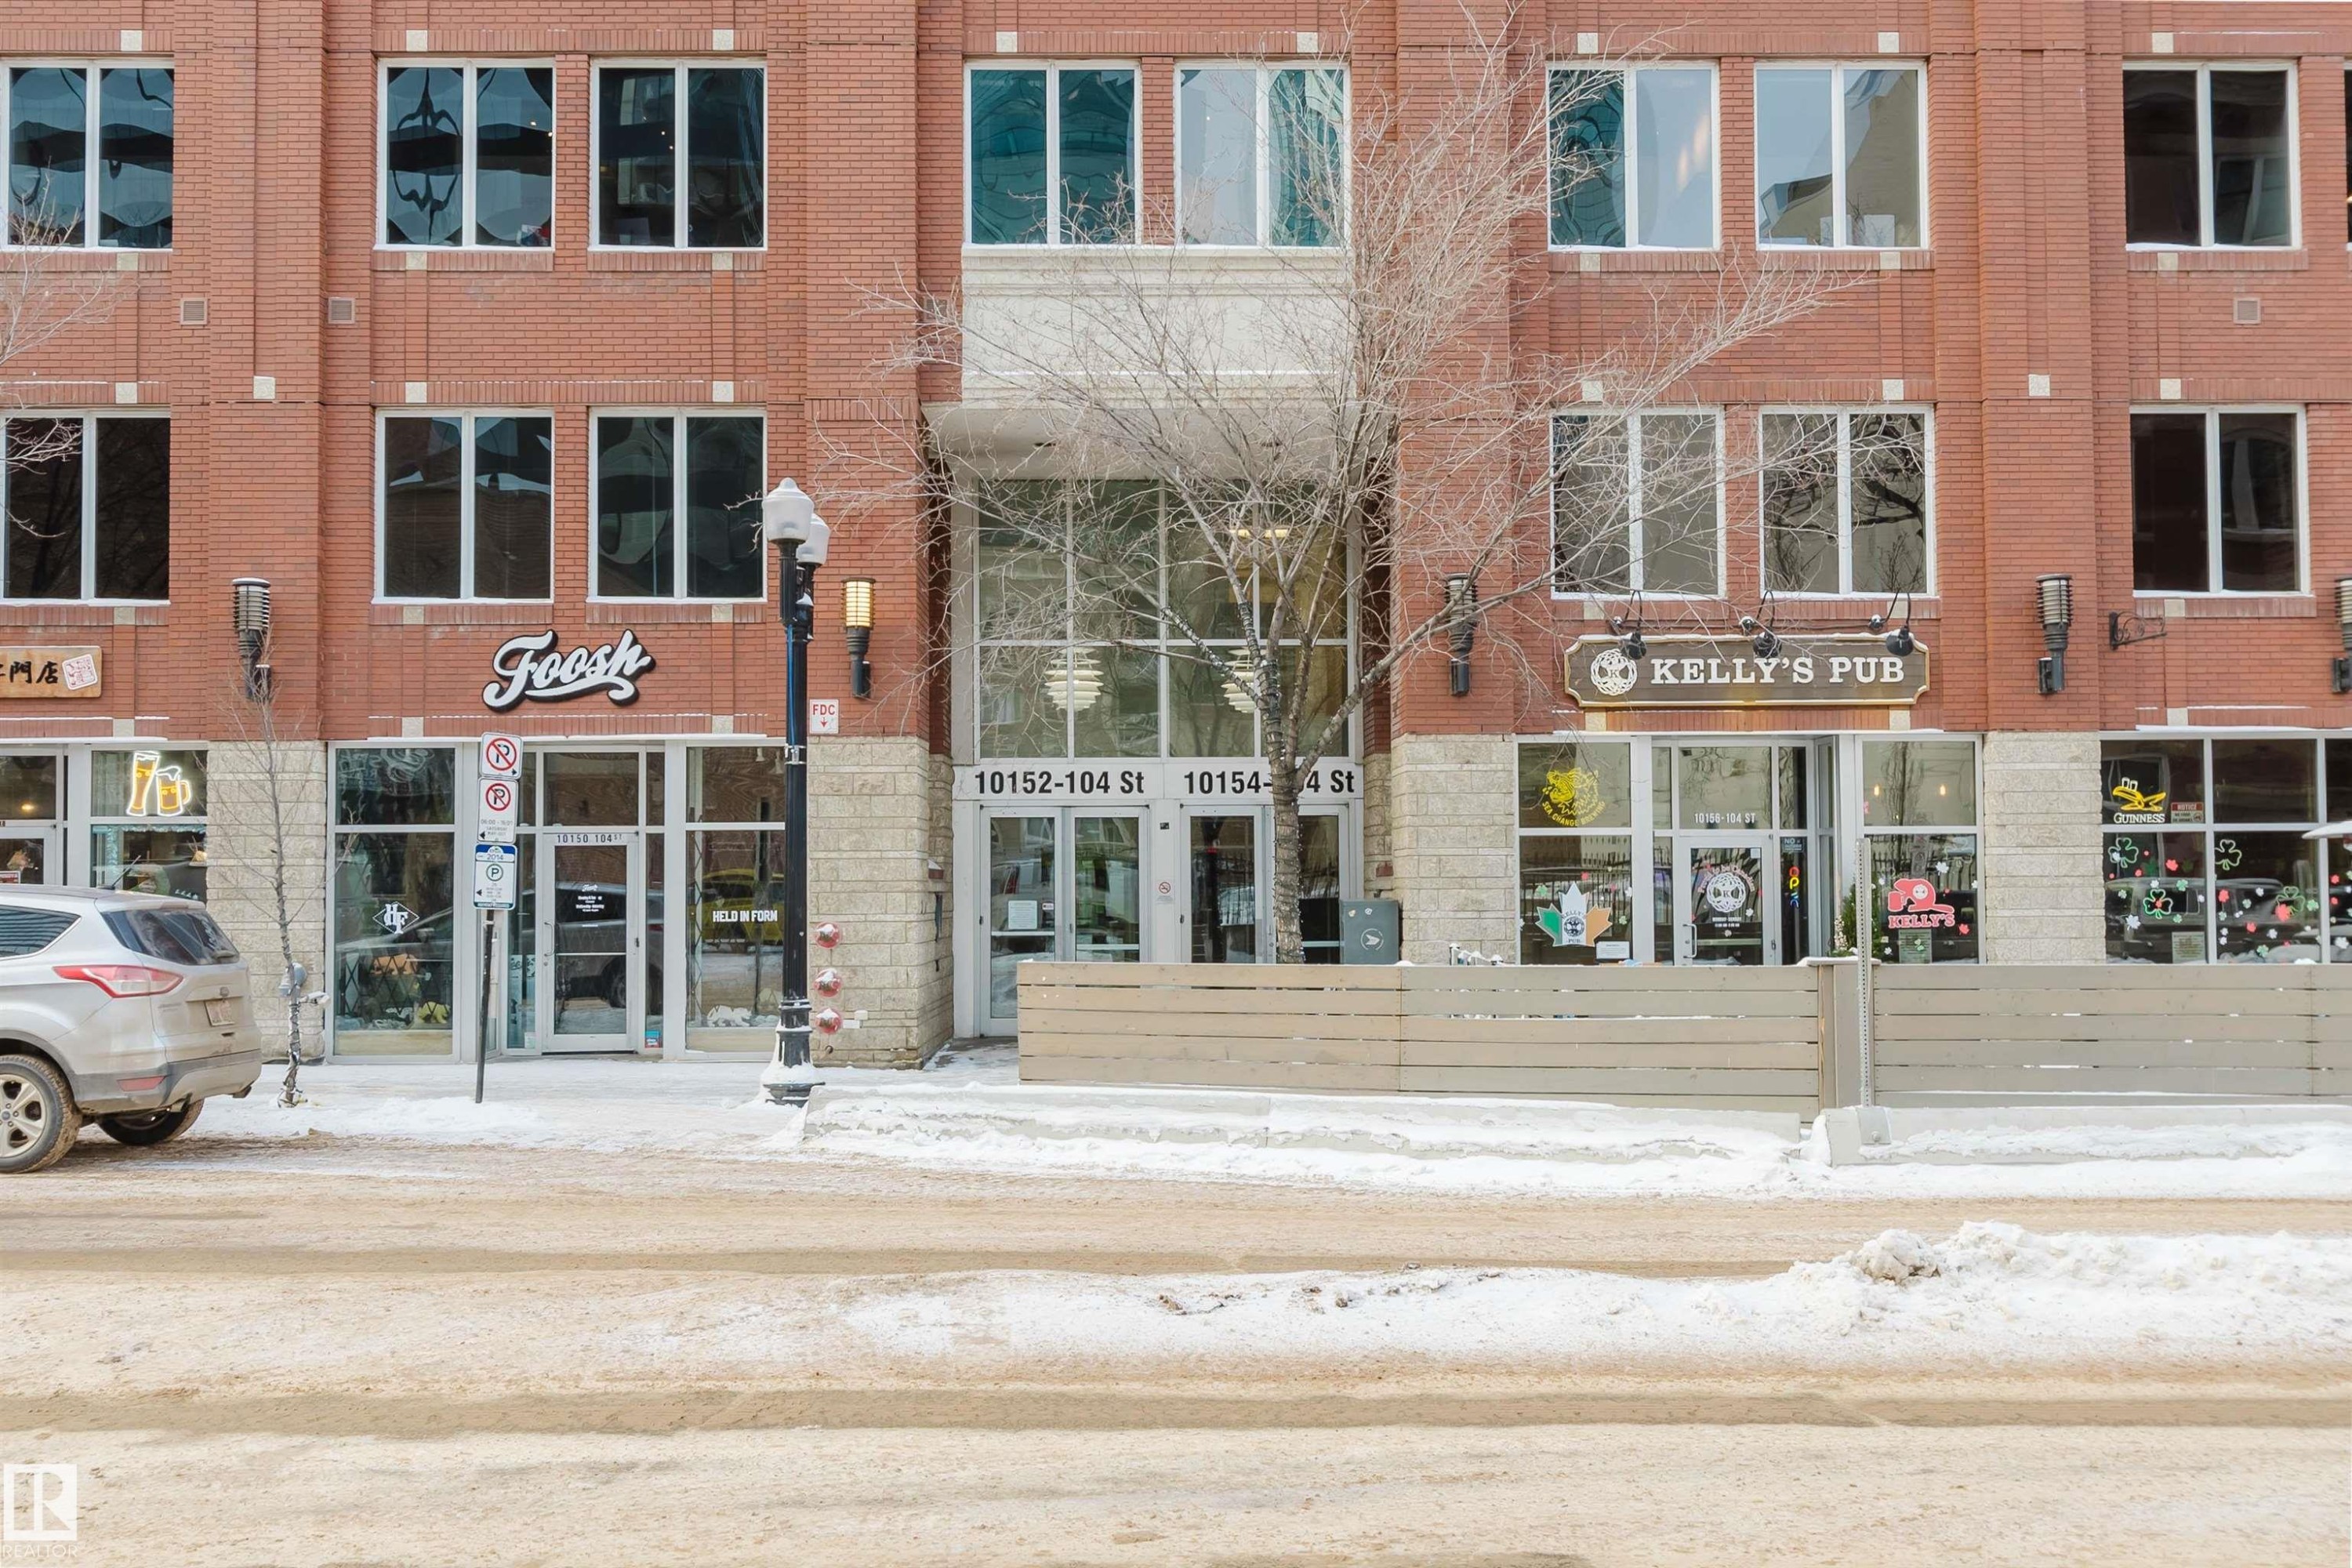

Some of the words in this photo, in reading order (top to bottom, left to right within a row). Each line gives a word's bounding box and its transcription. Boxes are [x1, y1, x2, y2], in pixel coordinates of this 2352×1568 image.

[0, 661, 59, 684] 門店
[482, 630, 655, 710] Foosh
[1650, 657, 1814, 684] KELLY'S
[1829, 657, 1904, 684] PUB
[813, 704, 836, 715] FDC
[975, 771, 1110, 794] 10152-104
[1120, 771, 1145, 794] St
[1184, 771, 1321, 793] 10154-4
[1330, 770, 1355, 793] St
[1542, 800, 1553, 815] SEA
[1552, 813, 1579, 827] CHANGE
[1744, 812, 1755, 824] ST
[2114, 812, 2165, 824] GUINNESS
[557, 834, 589, 843] 10150
[595, 834, 612, 843] 104
[491, 867, 499, 877] P
[713, 910, 738, 922] HELD
[739, 910, 750, 922] IN
[751, 909, 778, 922] FORM
[1888, 913, 1955, 928] KELLY'S
